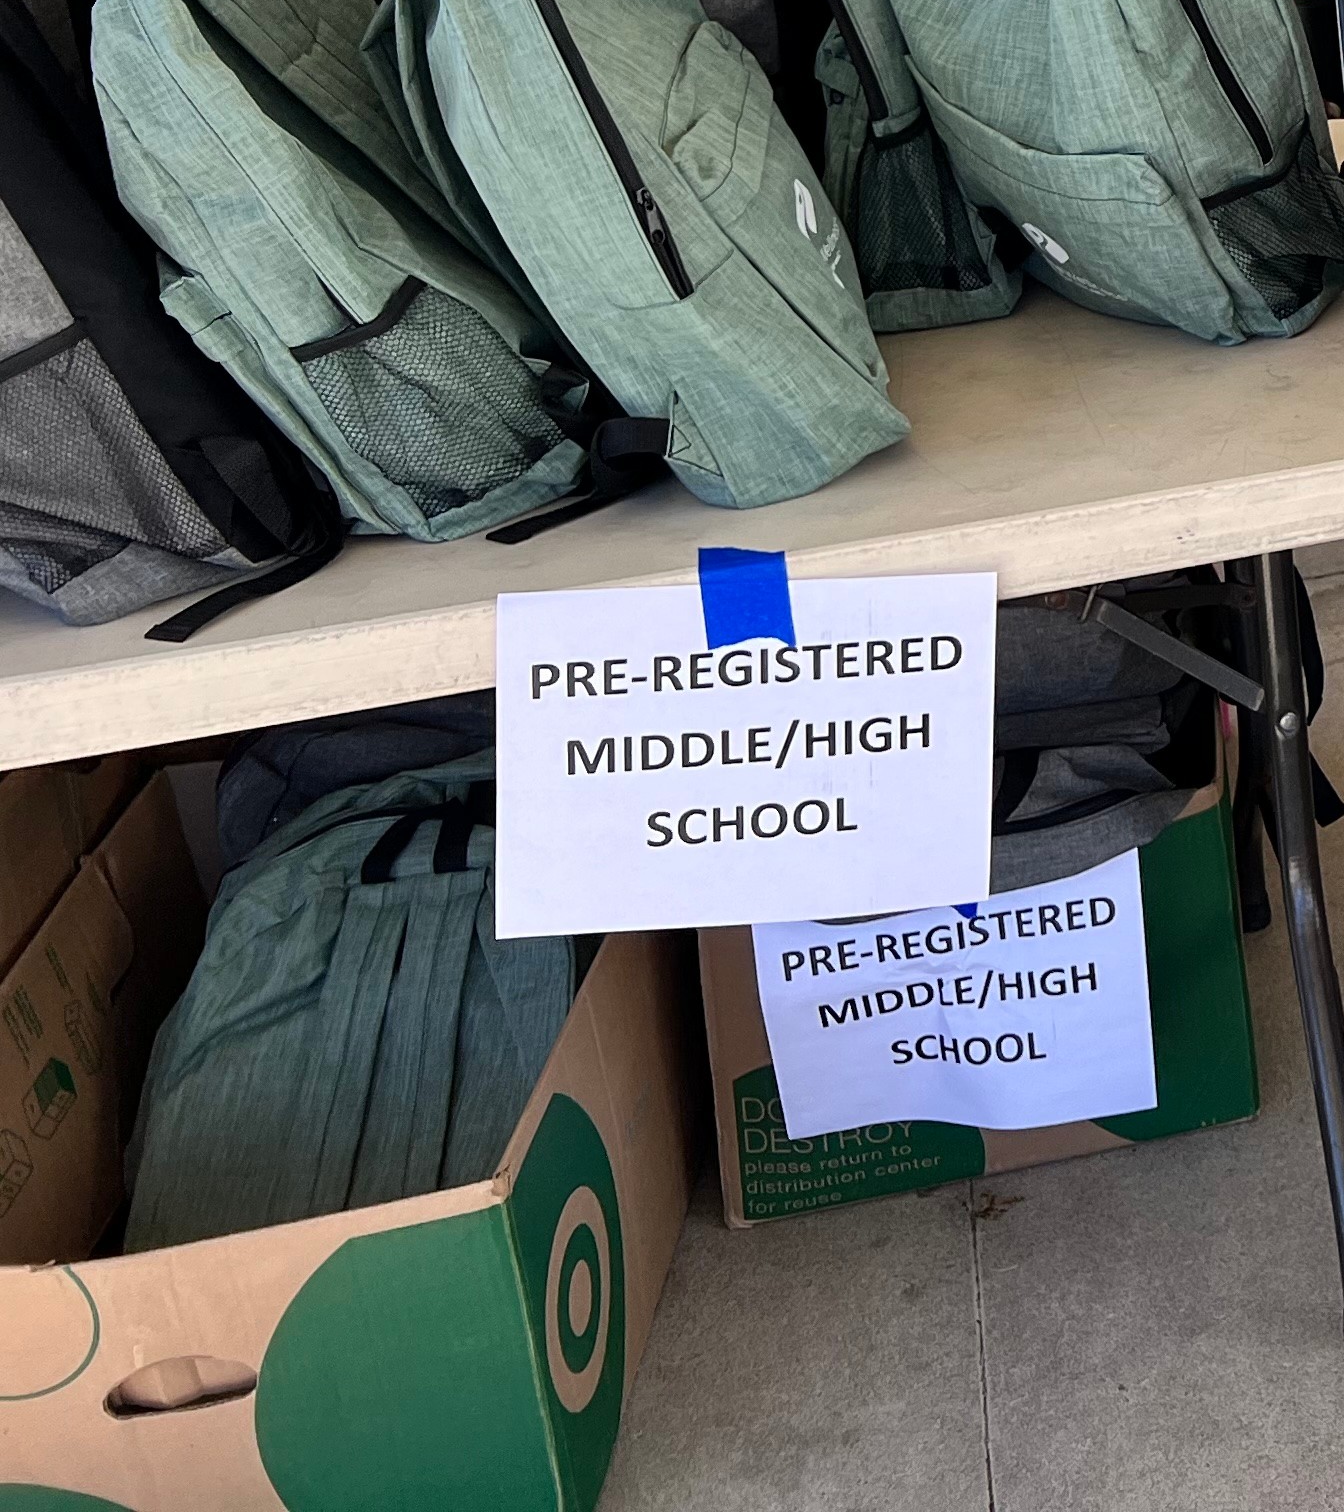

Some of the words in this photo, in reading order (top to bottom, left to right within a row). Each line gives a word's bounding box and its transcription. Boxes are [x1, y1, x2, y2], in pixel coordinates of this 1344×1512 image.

[530, 634, 963, 699] PRE-REGISTERED
[566, 712, 932, 776] MIDDLE/HIGH
[646, 797, 858, 847] SCHOOL
[781, 896, 1117, 982] PRE-REGISTERED
[818, 962, 1098, 1028] MIDDLE/HIGH
[890, 1031, 1047, 1065] SCHOOL
[745, 1160, 811, 1176] please
[819, 1148, 883, 1170] return
[891, 1144, 912, 1156] to
[746, 1169, 866, 1195] distribution
[875, 1155, 941, 1175] center
[748, 1199, 776, 1215] for
[784, 1192, 842, 1210] reuse
